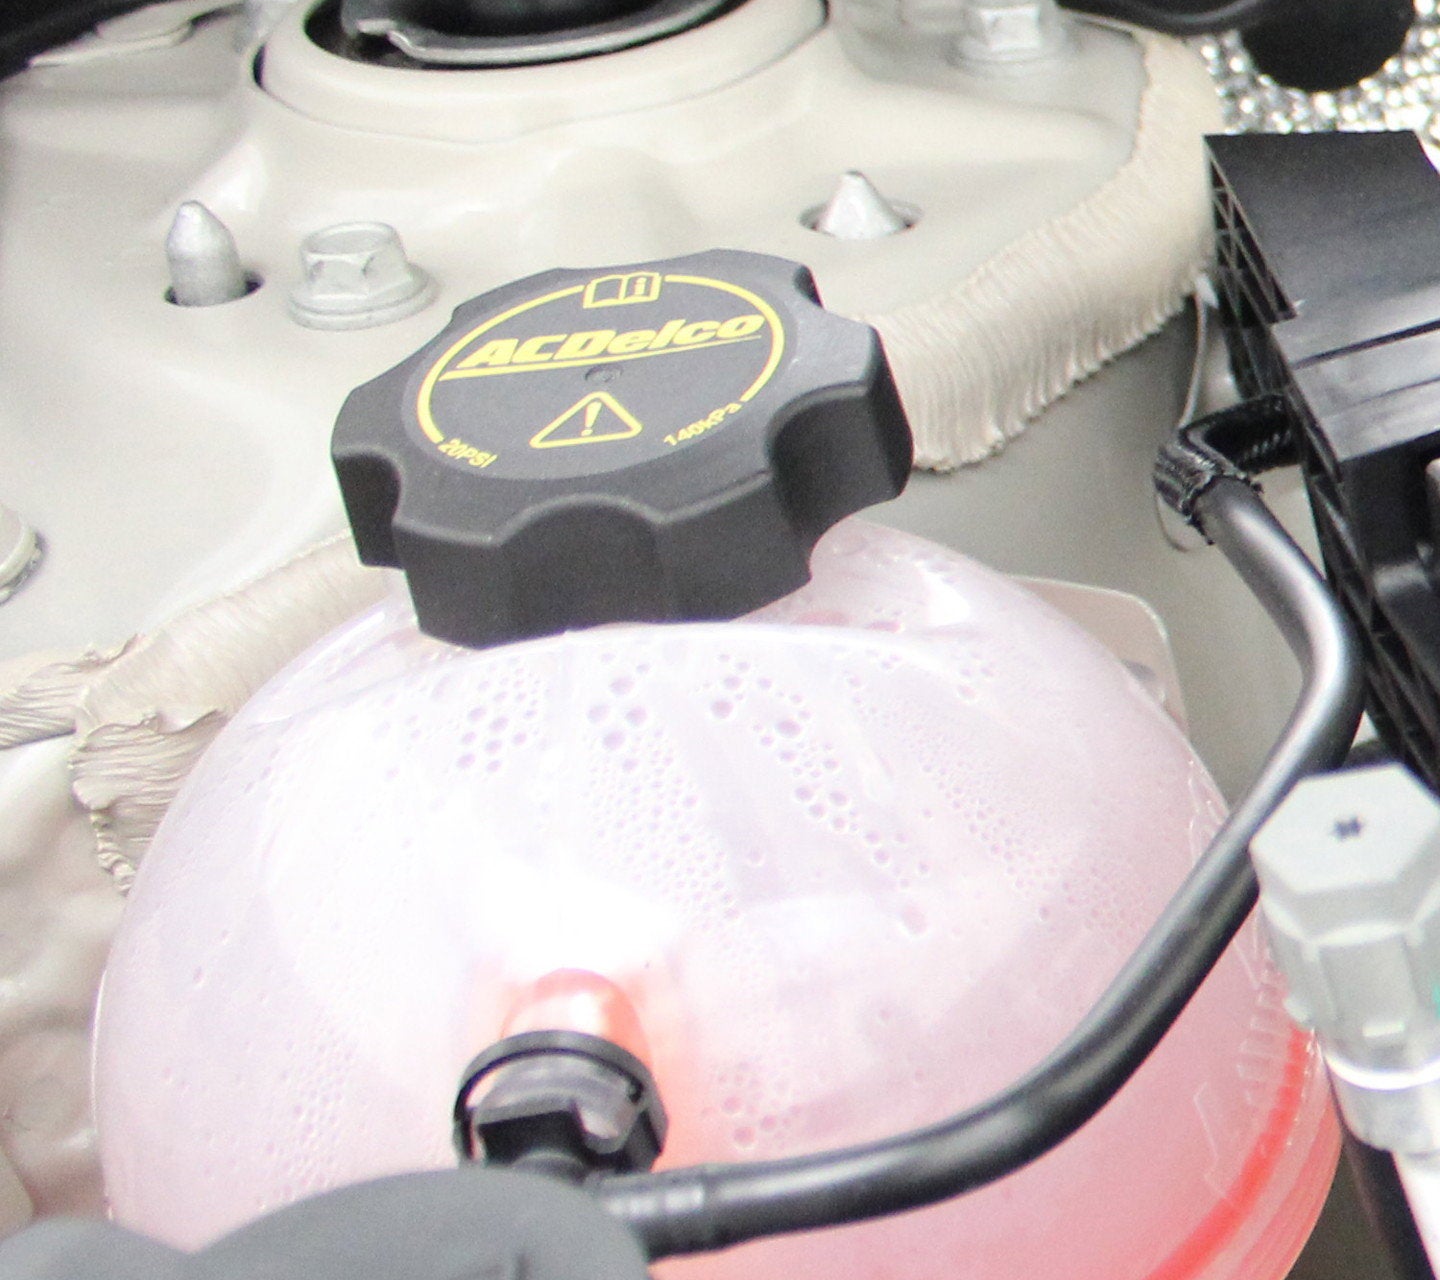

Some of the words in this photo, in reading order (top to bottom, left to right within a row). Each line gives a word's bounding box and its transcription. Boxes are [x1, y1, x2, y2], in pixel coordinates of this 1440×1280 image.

[455, 313, 766, 369] ACDelco
[663, 402, 743, 446] 140kPa
[437, 437, 498, 468] 20PSI
